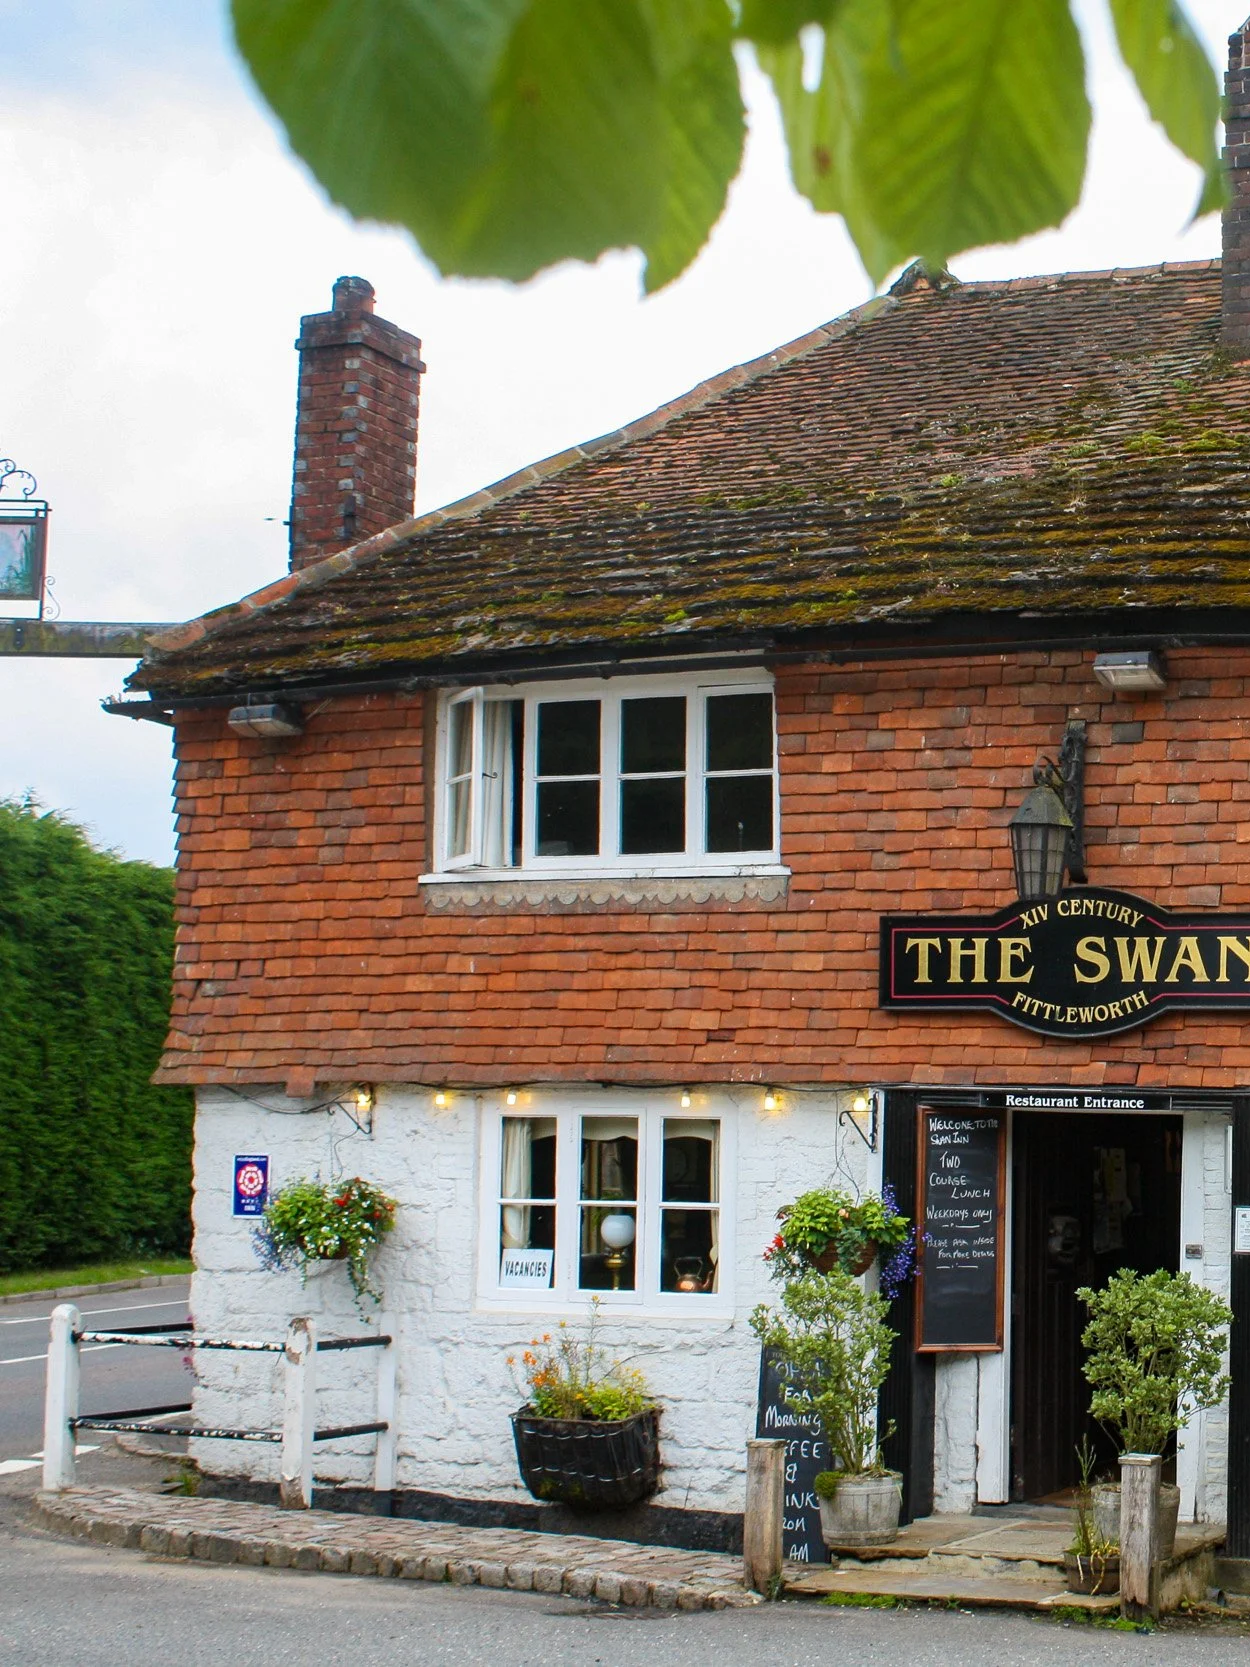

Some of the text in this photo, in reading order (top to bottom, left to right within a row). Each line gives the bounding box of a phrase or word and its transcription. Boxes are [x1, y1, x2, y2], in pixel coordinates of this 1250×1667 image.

[1019, 899, 1144, 929] XIV CENTURY
[905, 937, 1034, 983] THE
[1011, 990, 1150, 1024] FITTLEWORTH
[1006, 1095, 1145, 1108] Restaurant Entrance
[953, 1131, 969, 1144] INN
[940, 1151, 960, 1168] TWO
[929, 1173, 967, 1186] COURSE
[951, 1187, 990, 1199] LUNCH
[926, 1205, 968, 1220] WEEKDAYS
[505, 1261, 547, 1277] VACANCIES
[765, 1405, 821, 1436] MORNING
[789, 1543, 809, 1563] AM
